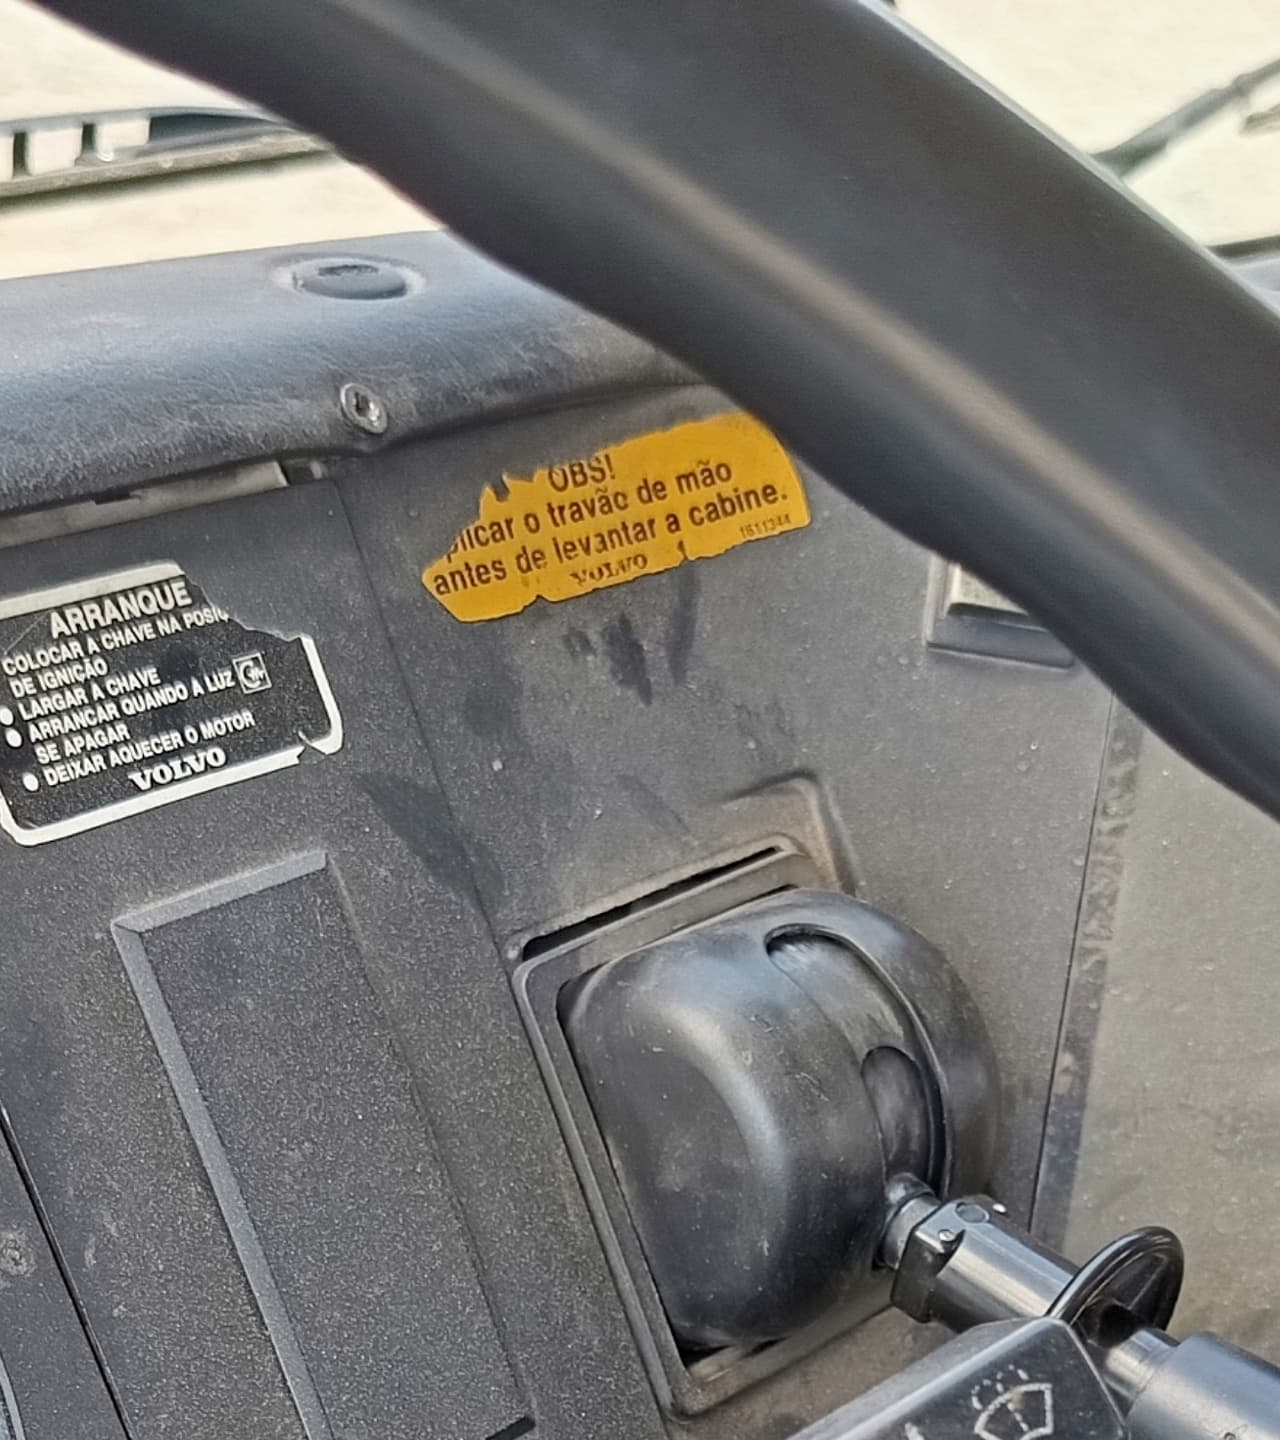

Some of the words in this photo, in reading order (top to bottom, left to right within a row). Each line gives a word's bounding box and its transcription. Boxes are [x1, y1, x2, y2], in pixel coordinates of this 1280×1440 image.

[524, 513, 540, 534] o
[546, 485, 628, 528] travão
[636, 477, 668, 505] de
[676, 459, 732, 494] mão
[433, 560, 507, 596] antes
[515, 545, 548, 575] de
[552, 518, 656, 563] levantar
[665, 512, 682, 533] a
[689, 480, 788, 527] cabine.
[51, 581, 193, 640] ARRANQUE
[1, 641, 84, 677] COLOCAR
[86, 636, 101, 655] A
[101, 622, 156, 651] CHAVE
[156, 613, 183, 637] NA
[9, 676, 37, 699] DE
[38, 655, 109, 692] IGNIÇÃO
[18, 686, 89, 721] LARGAR
[91, 680, 106, 701] A
[105, 666, 161, 697] CHAVE
[29, 701, 121, 743] ARRANCAR
[119, 680, 189, 716] QUANDO
[191, 676, 205, 698] A
[203, 668, 236, 694] LUZ
[35, 741, 61, 765] SE
[63, 722, 131, 758] APAGAR
[43, 752, 108, 787] DEIXAR
[109, 729, 185, 768] AQUECER
[184, 725, 199, 744] O
[199, 708, 256, 740] MOTOR
[127, 746, 227, 791] VOLVO
